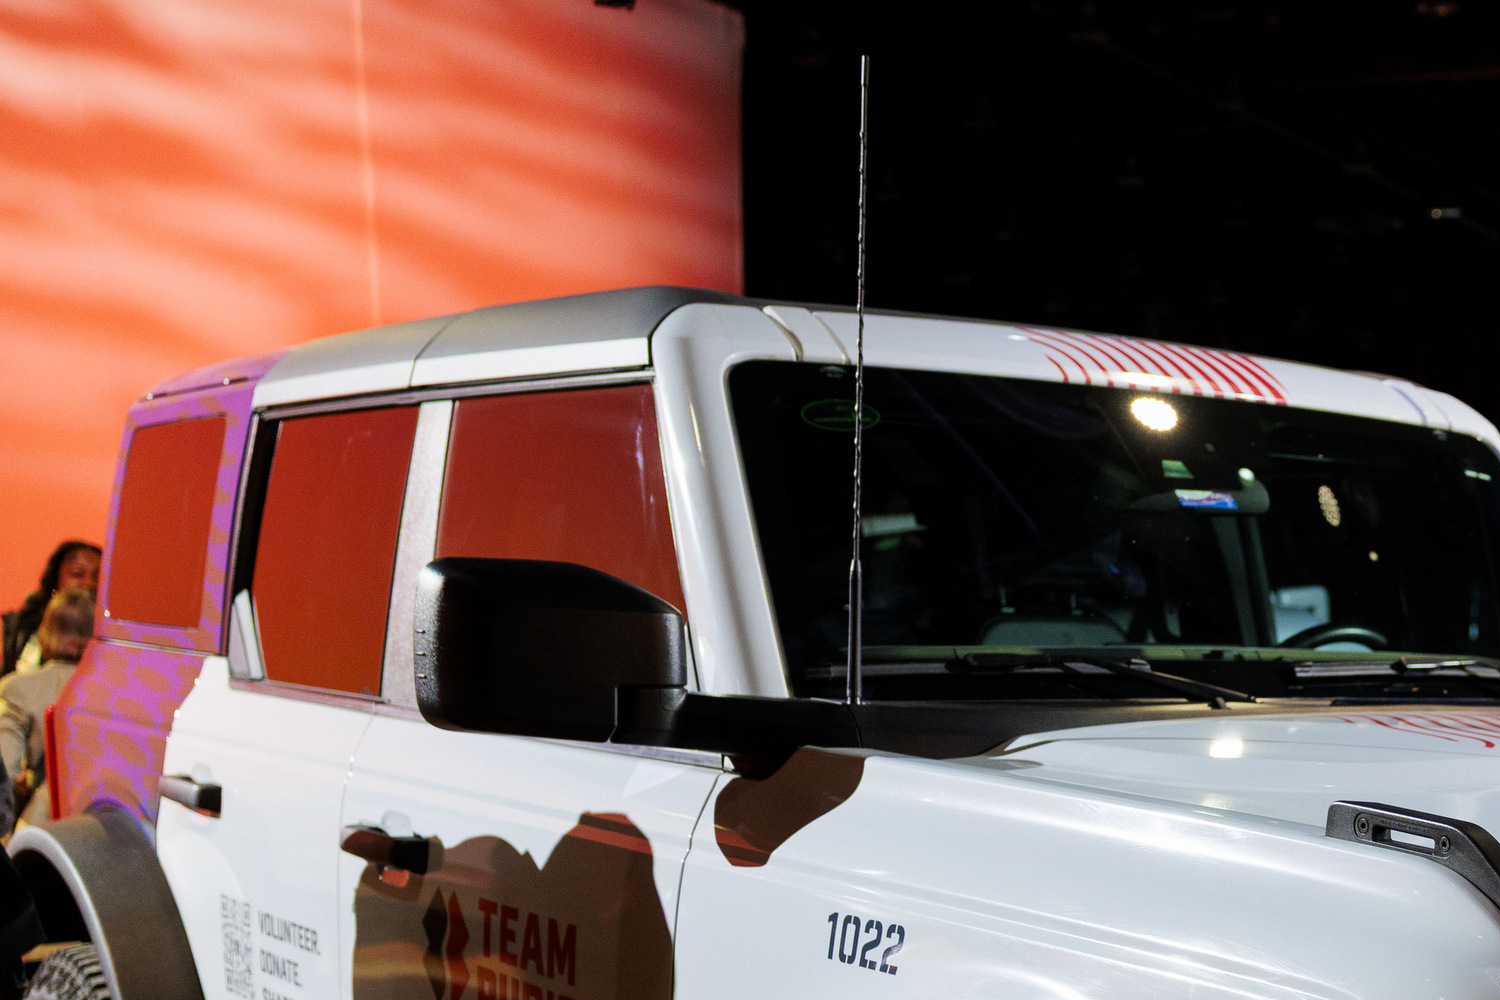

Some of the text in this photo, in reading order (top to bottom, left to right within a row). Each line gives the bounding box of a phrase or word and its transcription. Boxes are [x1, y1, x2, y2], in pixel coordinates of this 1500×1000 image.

[258, 910, 321, 956] VOLUNTEER.
[478, 897, 577, 986] TEAM
[827, 911, 906, 976] 1022
[260, 949, 302, 987] DONATE.
